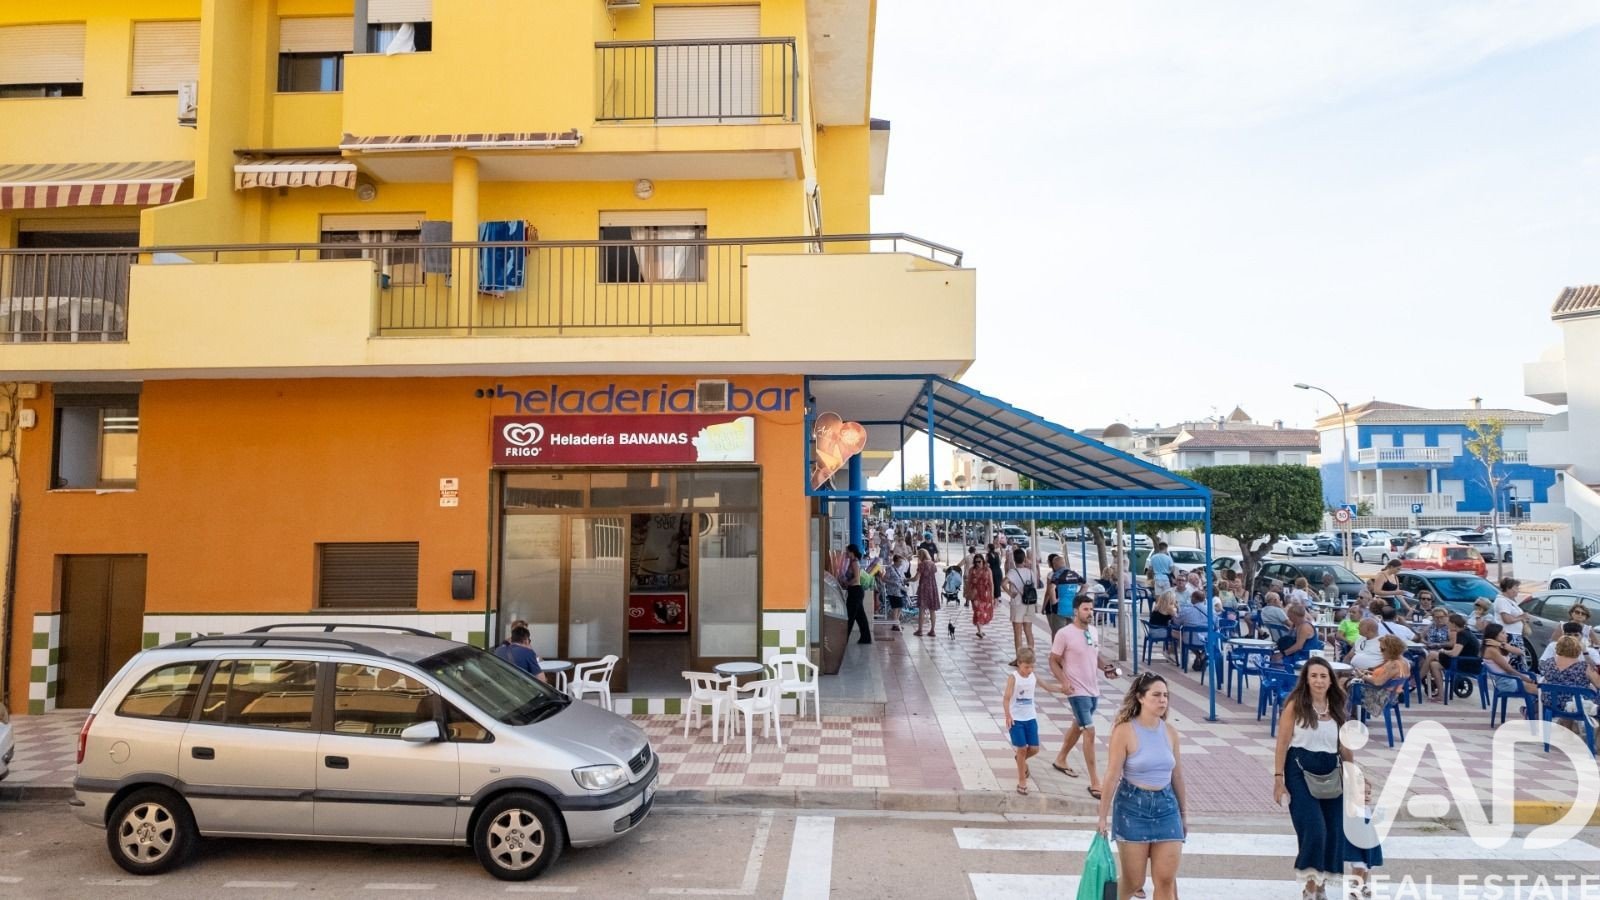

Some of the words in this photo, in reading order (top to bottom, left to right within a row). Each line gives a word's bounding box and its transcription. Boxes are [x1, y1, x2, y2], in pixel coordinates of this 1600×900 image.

[496, 383, 696, 414] heladeria
[726, 382, 800, 412] bar
[550, 432, 616, 446] Heladería
[619, 432, 689, 446] BANANAS
